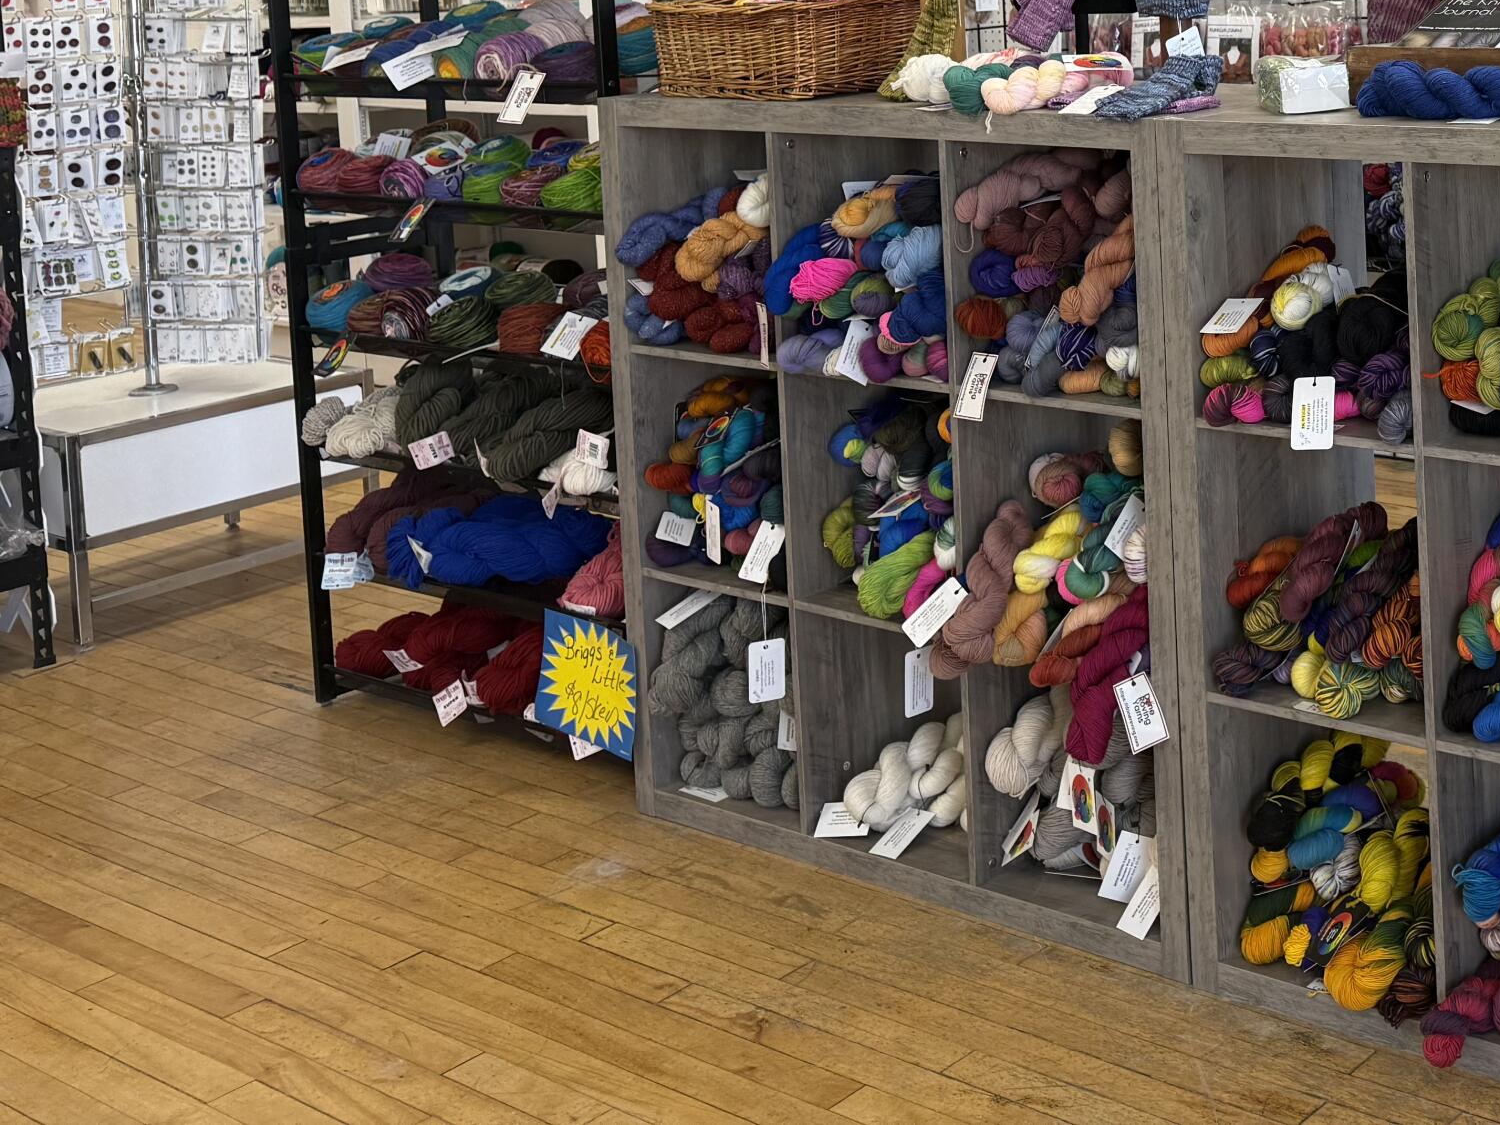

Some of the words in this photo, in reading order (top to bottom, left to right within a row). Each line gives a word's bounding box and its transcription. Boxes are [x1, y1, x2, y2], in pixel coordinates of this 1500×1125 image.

[1434, 7, 1497, 16] Journal
[563, 634, 602, 669] Briggs
[592, 666, 626, 693] Little
[1133, 696, 1144, 724] Yarns
